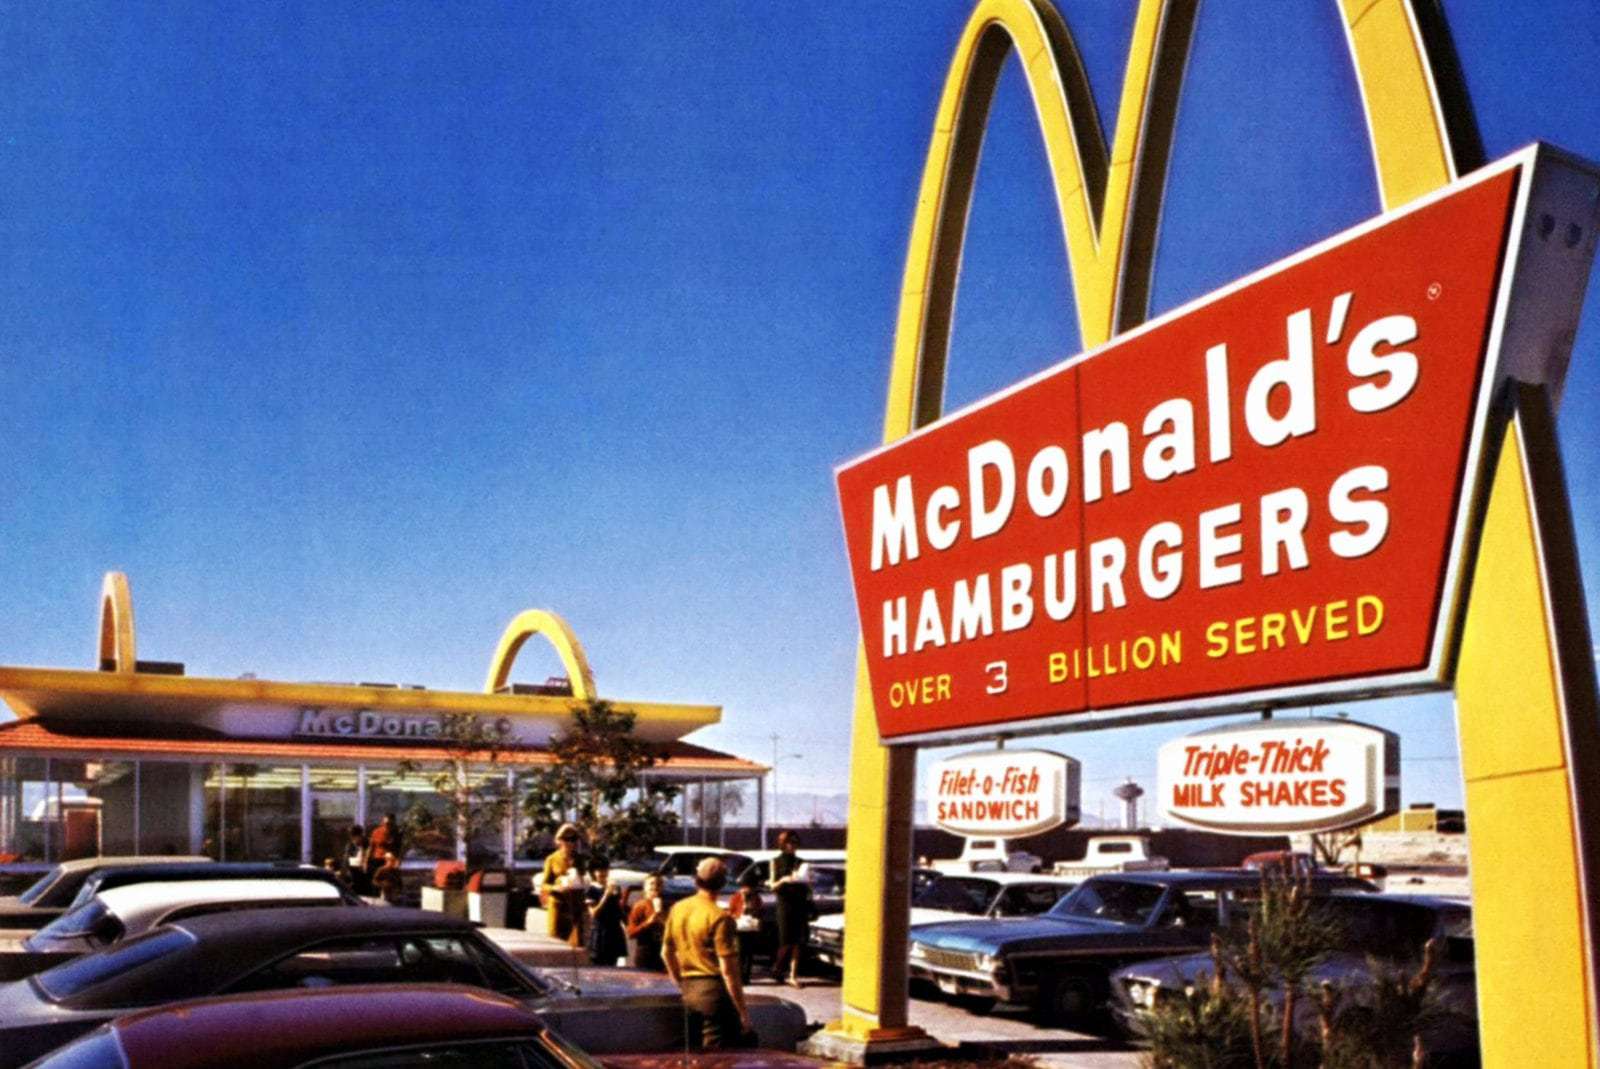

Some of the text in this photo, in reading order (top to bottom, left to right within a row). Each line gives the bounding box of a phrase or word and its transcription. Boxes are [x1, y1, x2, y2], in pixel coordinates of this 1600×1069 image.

[870, 291, 1419, 571] McDonald's
[881, 465, 1390, 657] HAMBURGERS
[889, 595, 1384, 709] OVER 3 BILLION SERVED
[300, 709, 498, 740] McDonas
[1183, 738, 1330, 780] Triple-Thick
[938, 766, 1040, 796] Filet-o-Fish
[1173, 779, 1346, 807] MILK SHAKES
[938, 800, 1039, 821] SANDWICH
